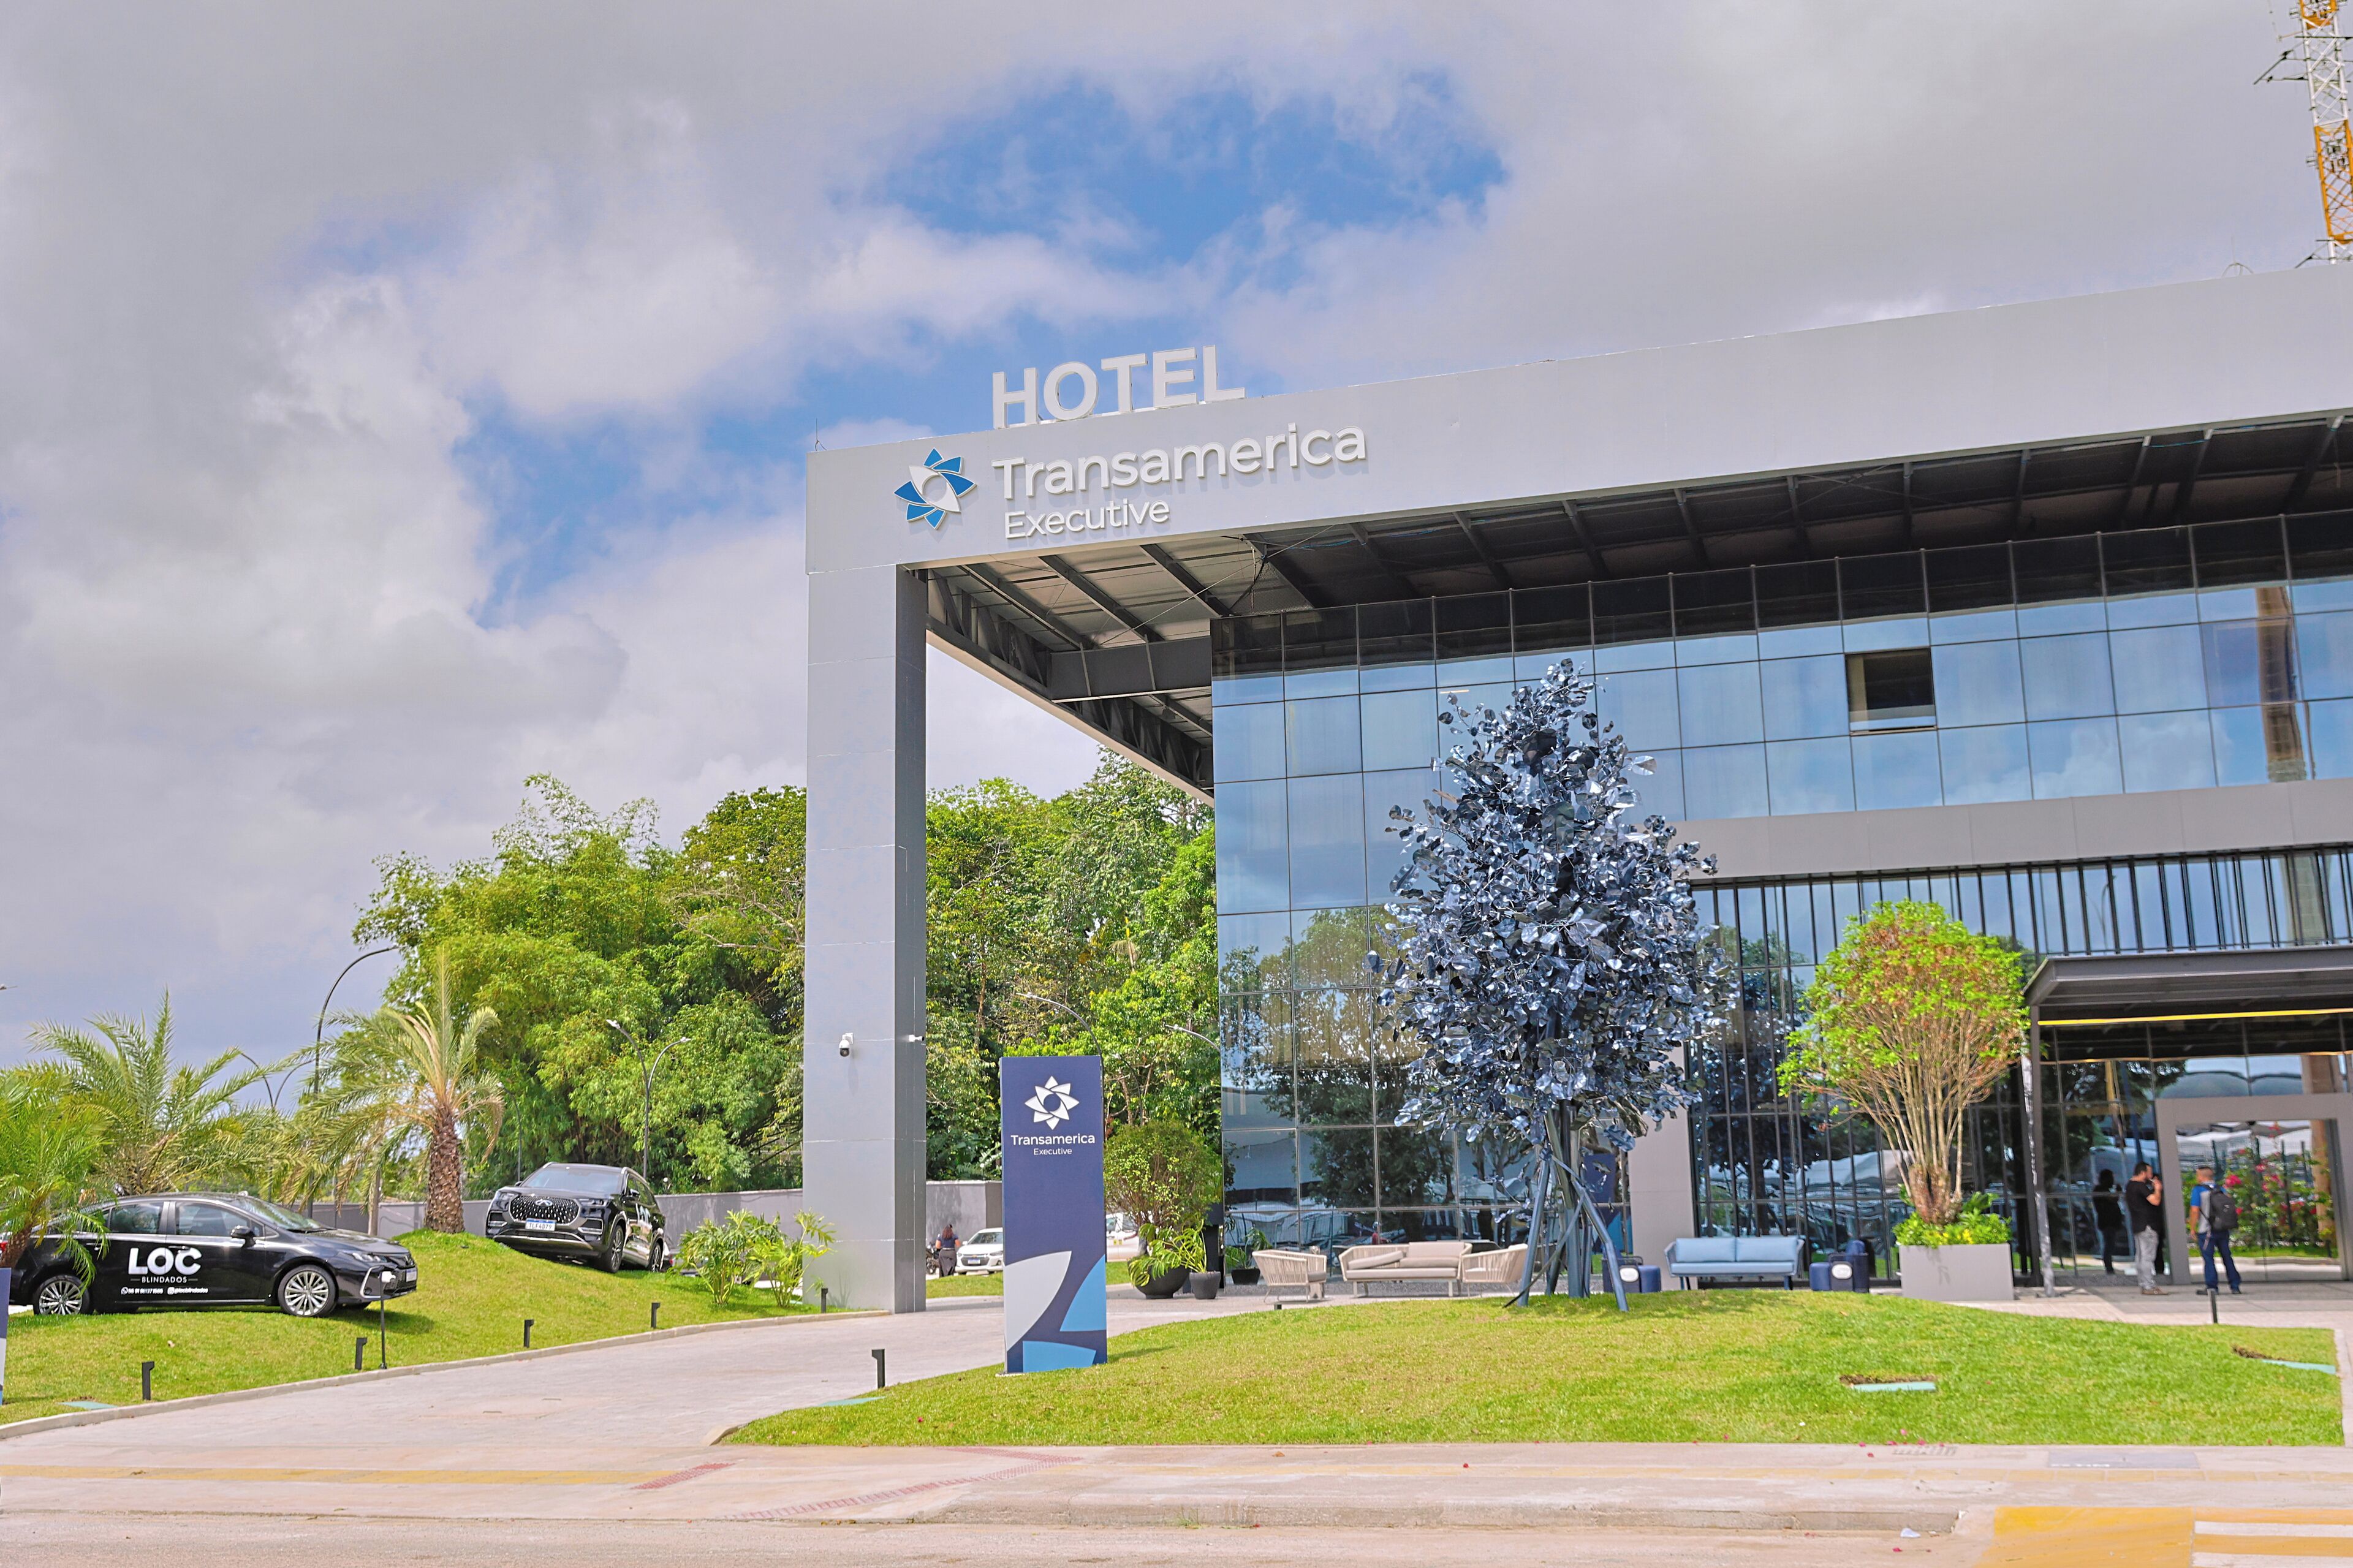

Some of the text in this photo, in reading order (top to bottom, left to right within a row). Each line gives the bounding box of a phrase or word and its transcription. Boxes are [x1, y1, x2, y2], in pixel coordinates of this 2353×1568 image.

[992, 344, 1246, 430] HOTEL
[991, 422, 1366, 500] Transamerica
[1004, 498, 1170, 539] Executive
[1010, 1133, 1096, 1146] Transamerica
[127, 1247, 202, 1275] LOC
